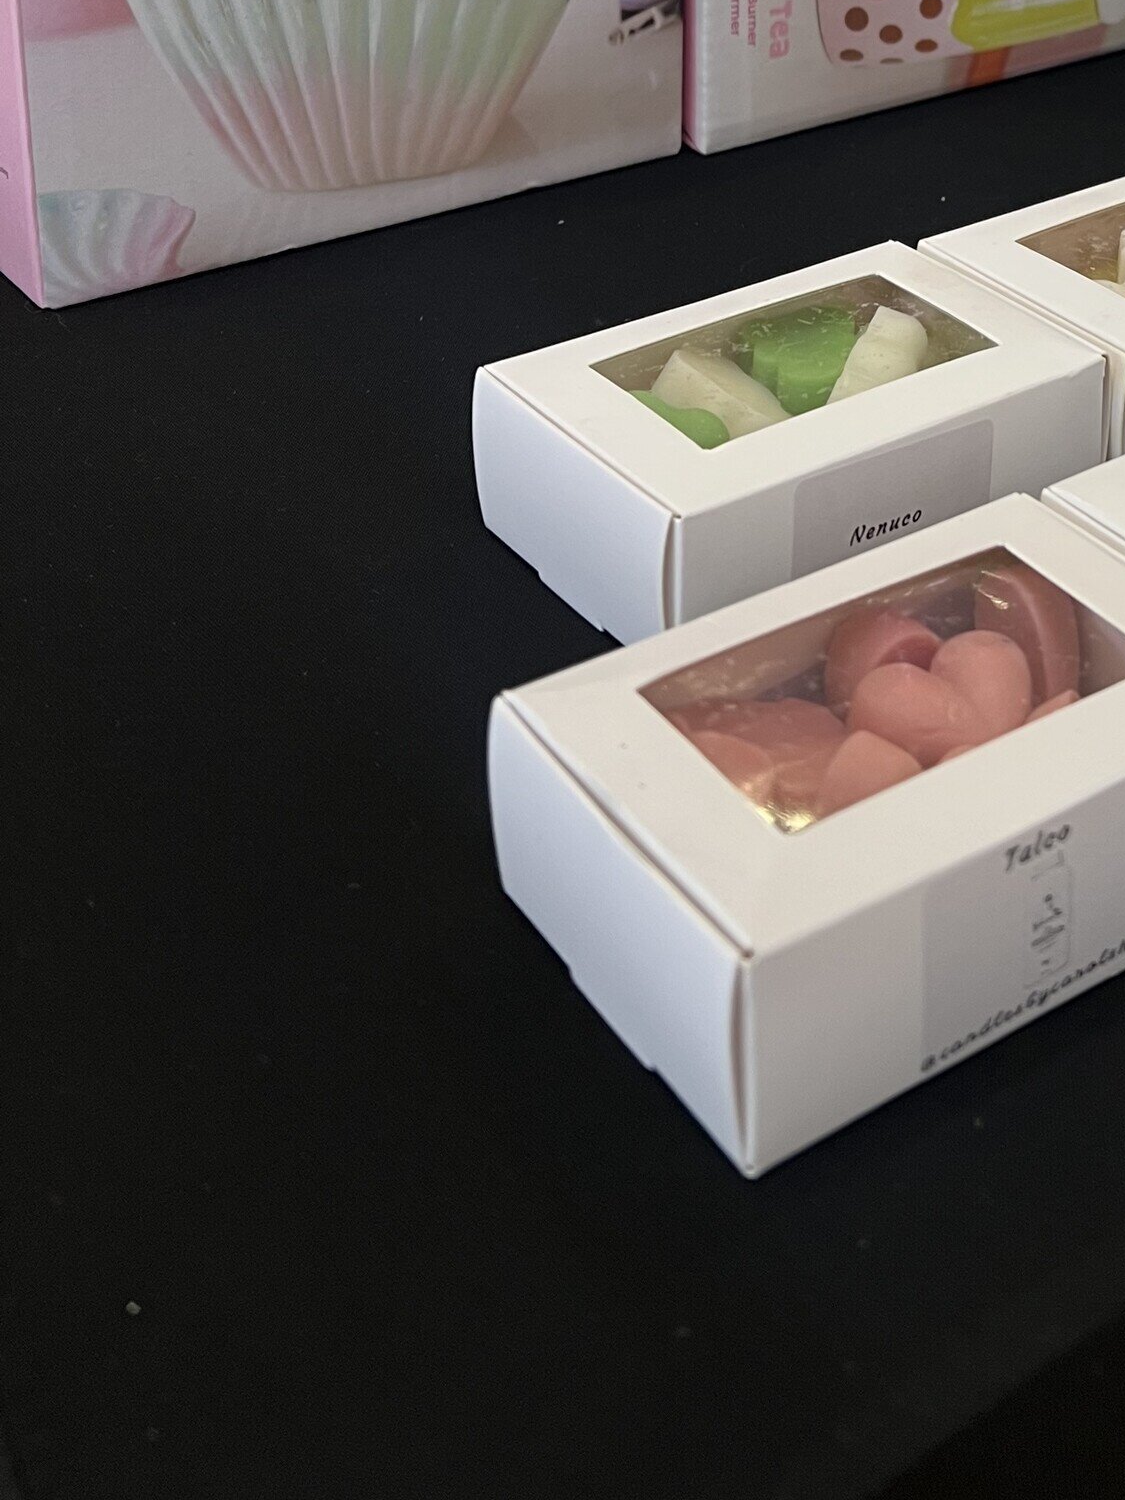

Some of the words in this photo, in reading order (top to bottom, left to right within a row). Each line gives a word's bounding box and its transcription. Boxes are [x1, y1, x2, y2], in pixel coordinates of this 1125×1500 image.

[769, 0, 793, 60] Tea
[849, 509, 922, 547] Nenuco
[1003, 823, 1071, 874] Talco
